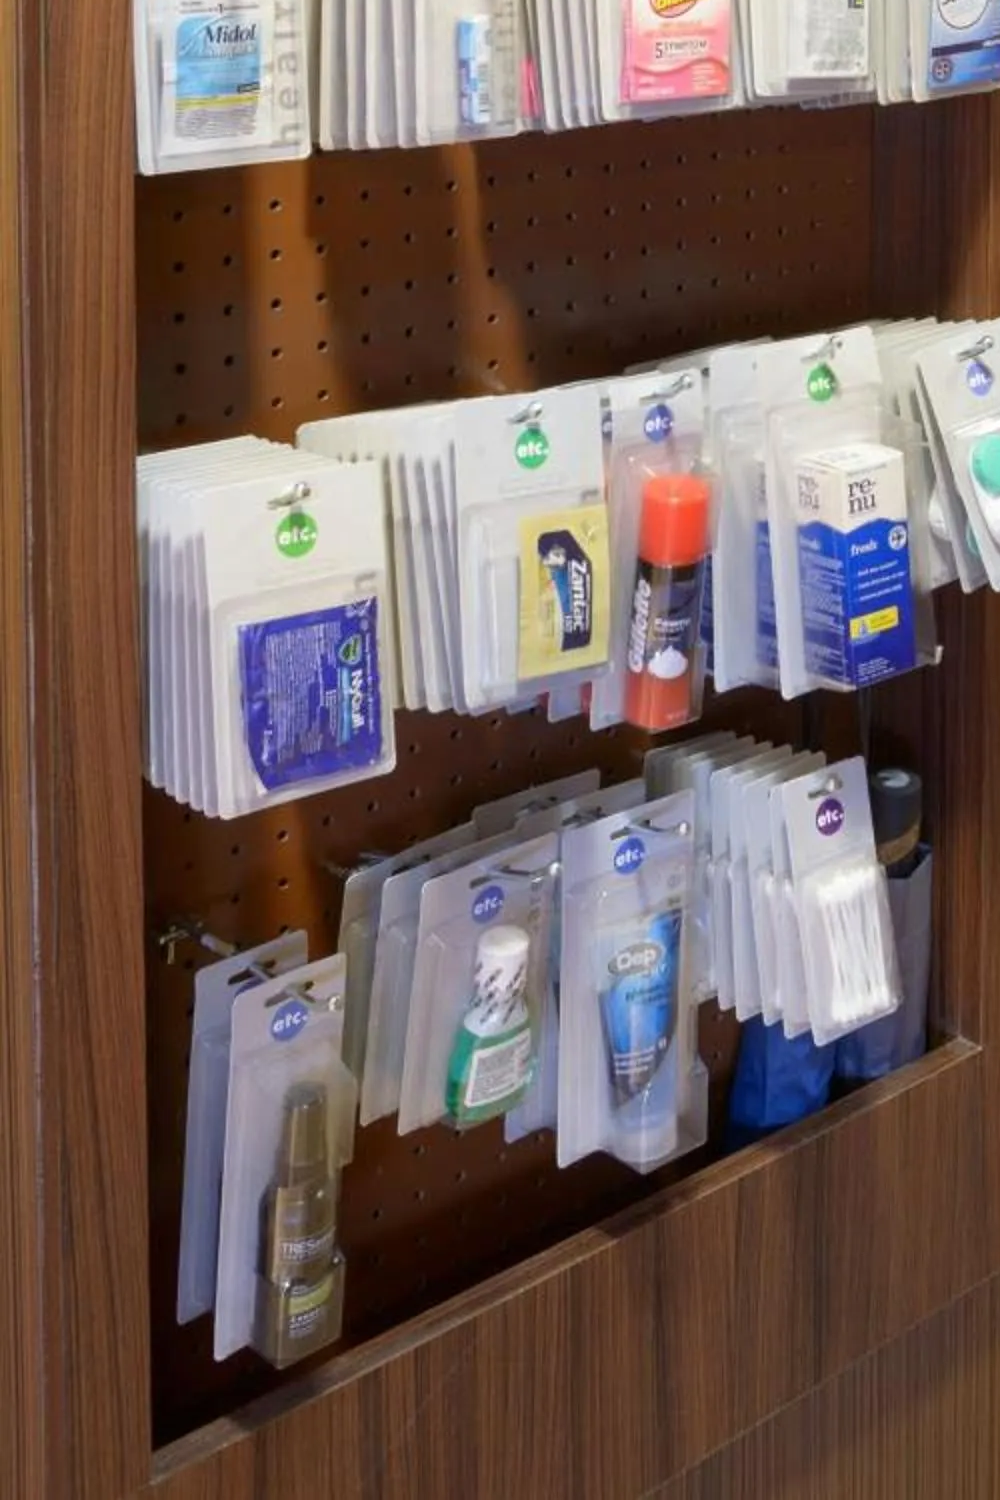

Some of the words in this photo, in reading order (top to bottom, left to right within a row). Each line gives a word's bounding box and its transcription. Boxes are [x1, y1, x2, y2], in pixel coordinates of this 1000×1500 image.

[205, 23, 257, 44] Midol
[645, 416, 674, 433] etc.
[515, 441, 549, 459] etc.
[847, 494, 877, 514] nu
[279, 526, 317, 546] etc.
[570, 560, 588, 632] Zantac
[628, 579, 651, 673] Gillette
[818, 810, 845, 827] etc.
[615, 850, 645, 867] etc.
[474, 896, 504, 915] etc.
[273, 1012, 309, 1033] etc.
